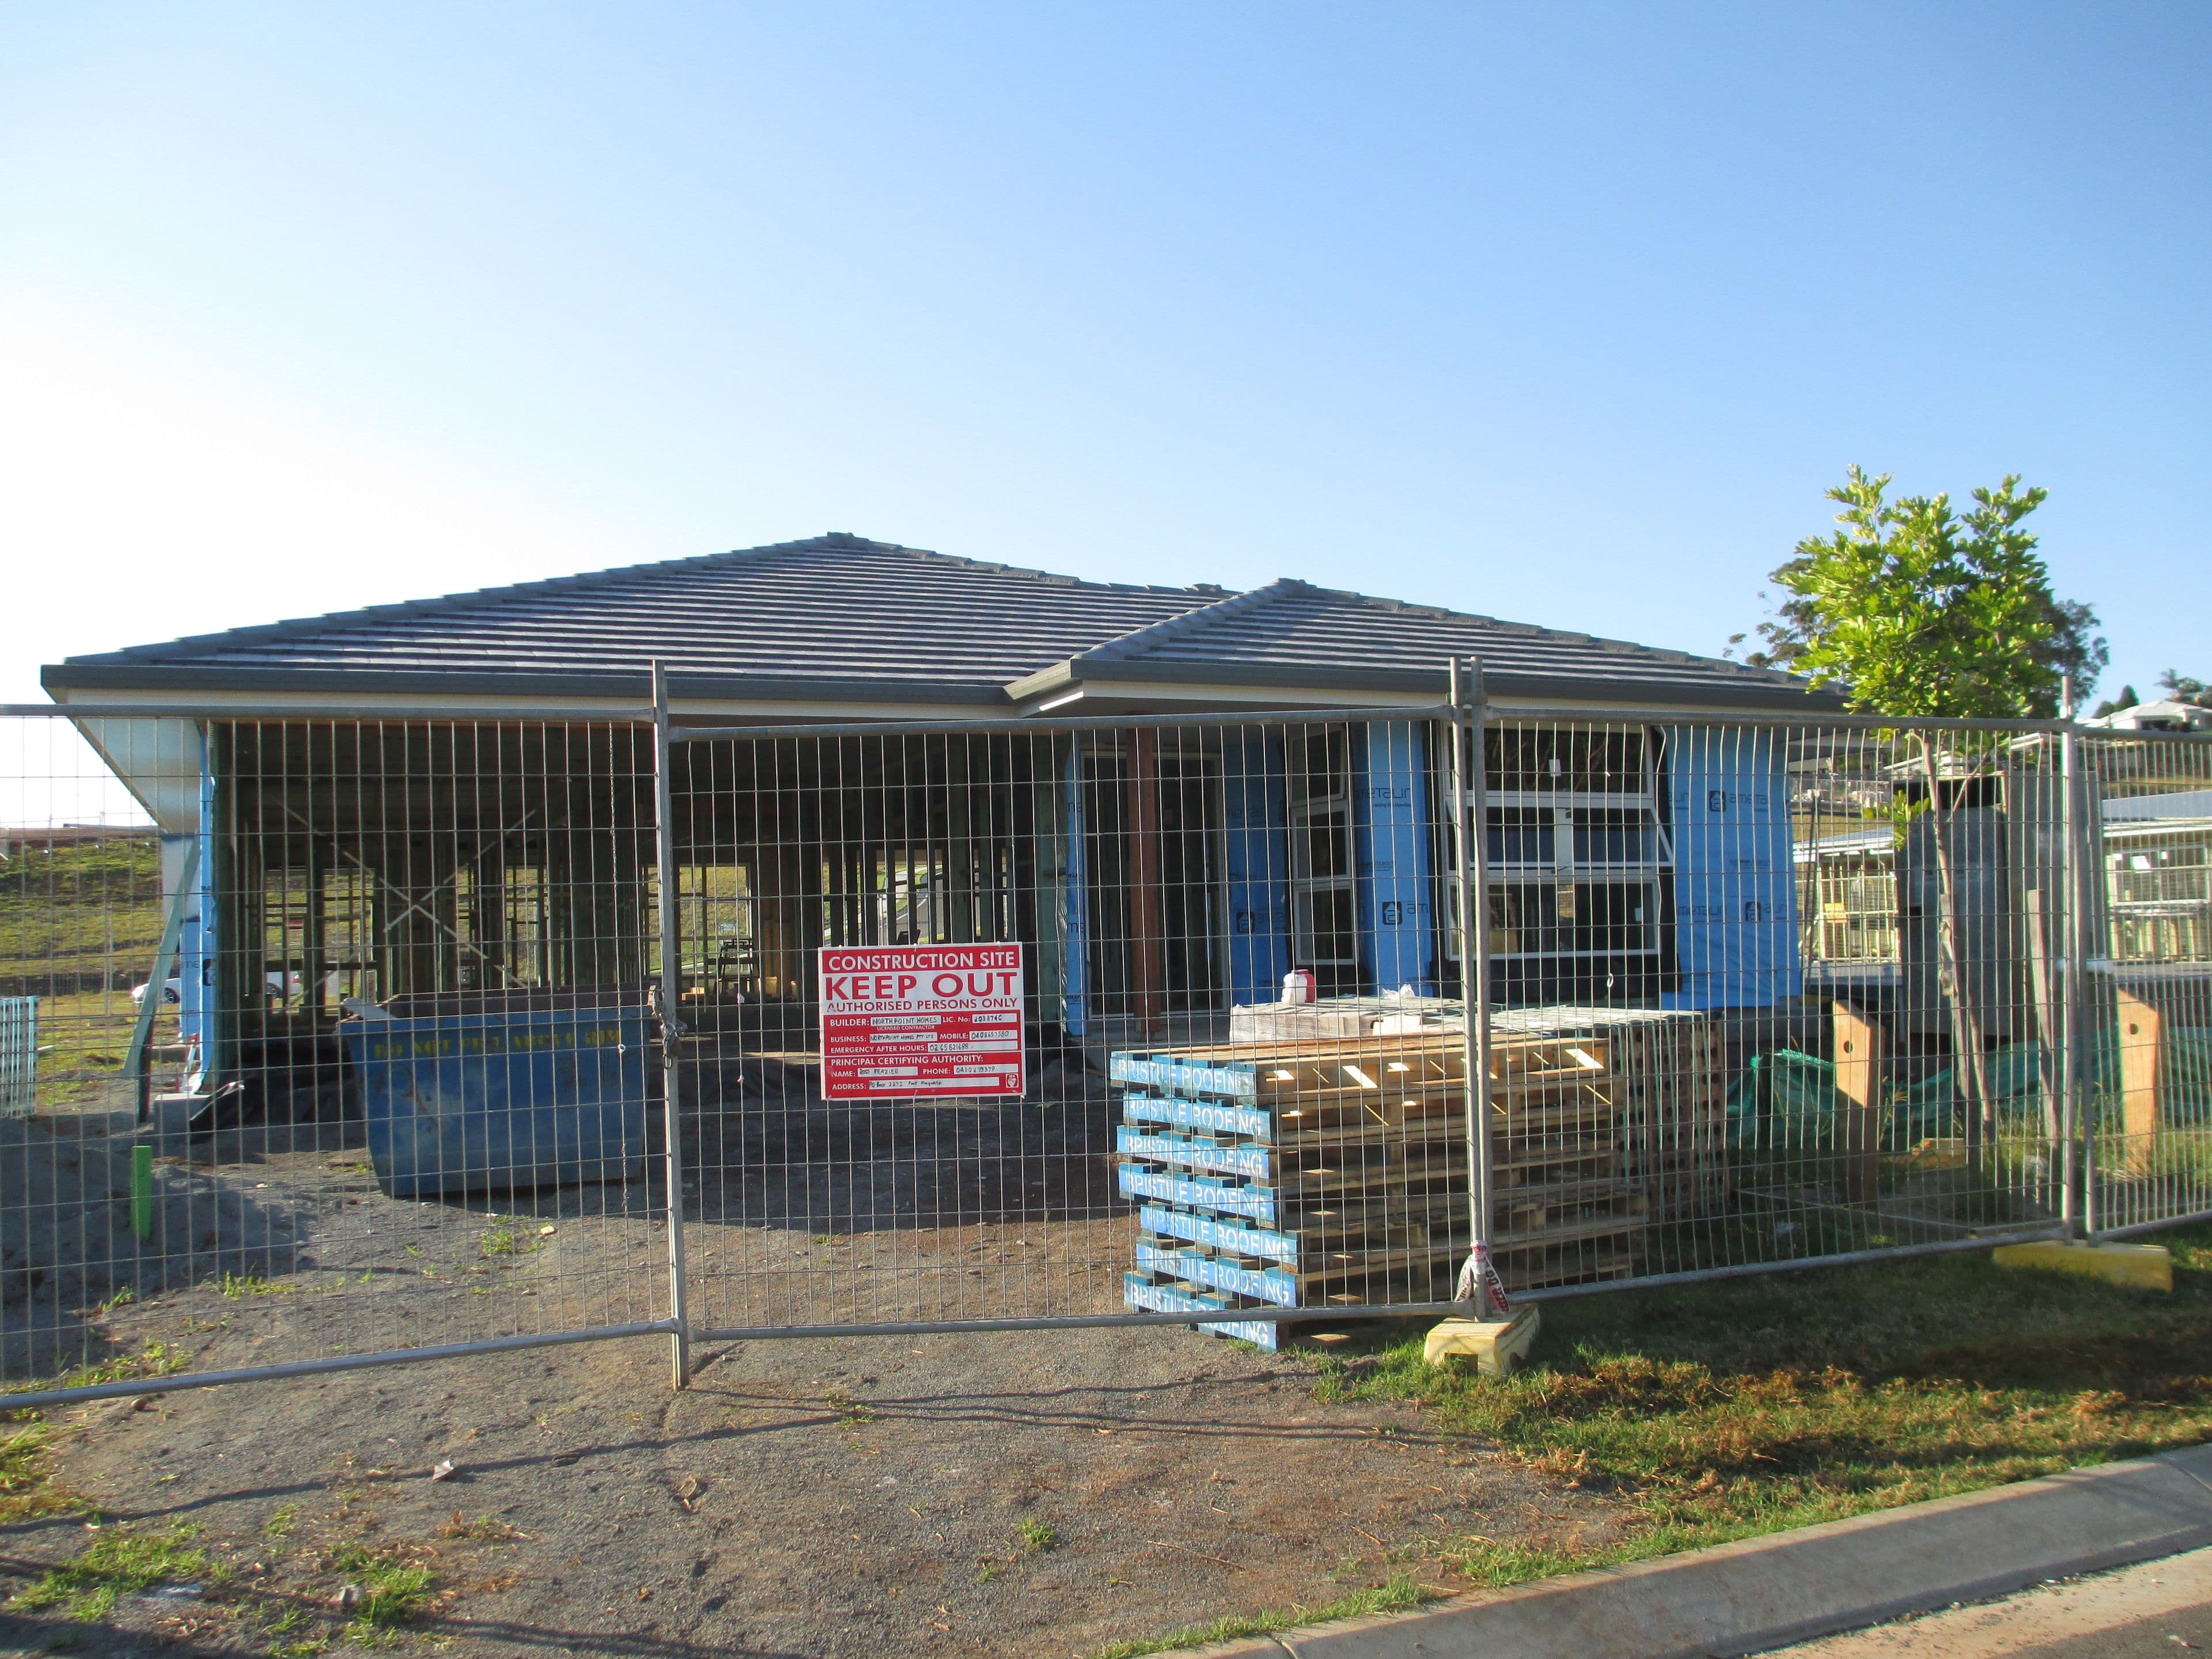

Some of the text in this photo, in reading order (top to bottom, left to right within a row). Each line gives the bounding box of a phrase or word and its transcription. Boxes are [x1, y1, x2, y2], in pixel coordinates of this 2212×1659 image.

[828, 951, 1014, 971] CONSTRUCTION SITE
[825, 972, 1017, 1001] KEEP OUT
[827, 998, 1017, 1012] AUTHORISED PERSONS ONLY
[830, 1018, 869, 1027] BUILDER:
[878, 1056, 929, 1065] CERTIFYING
[931, 1055, 983, 1063] AUTHORITY:
[1125, 1135, 1262, 1175] BRISTILE ROOFNG
[1126, 1173, 1188, 1204] BRISTILE
[1217, 1225, 1289, 1262] ROOFING
[1215, 1266, 1289, 1303] ROOFNG
